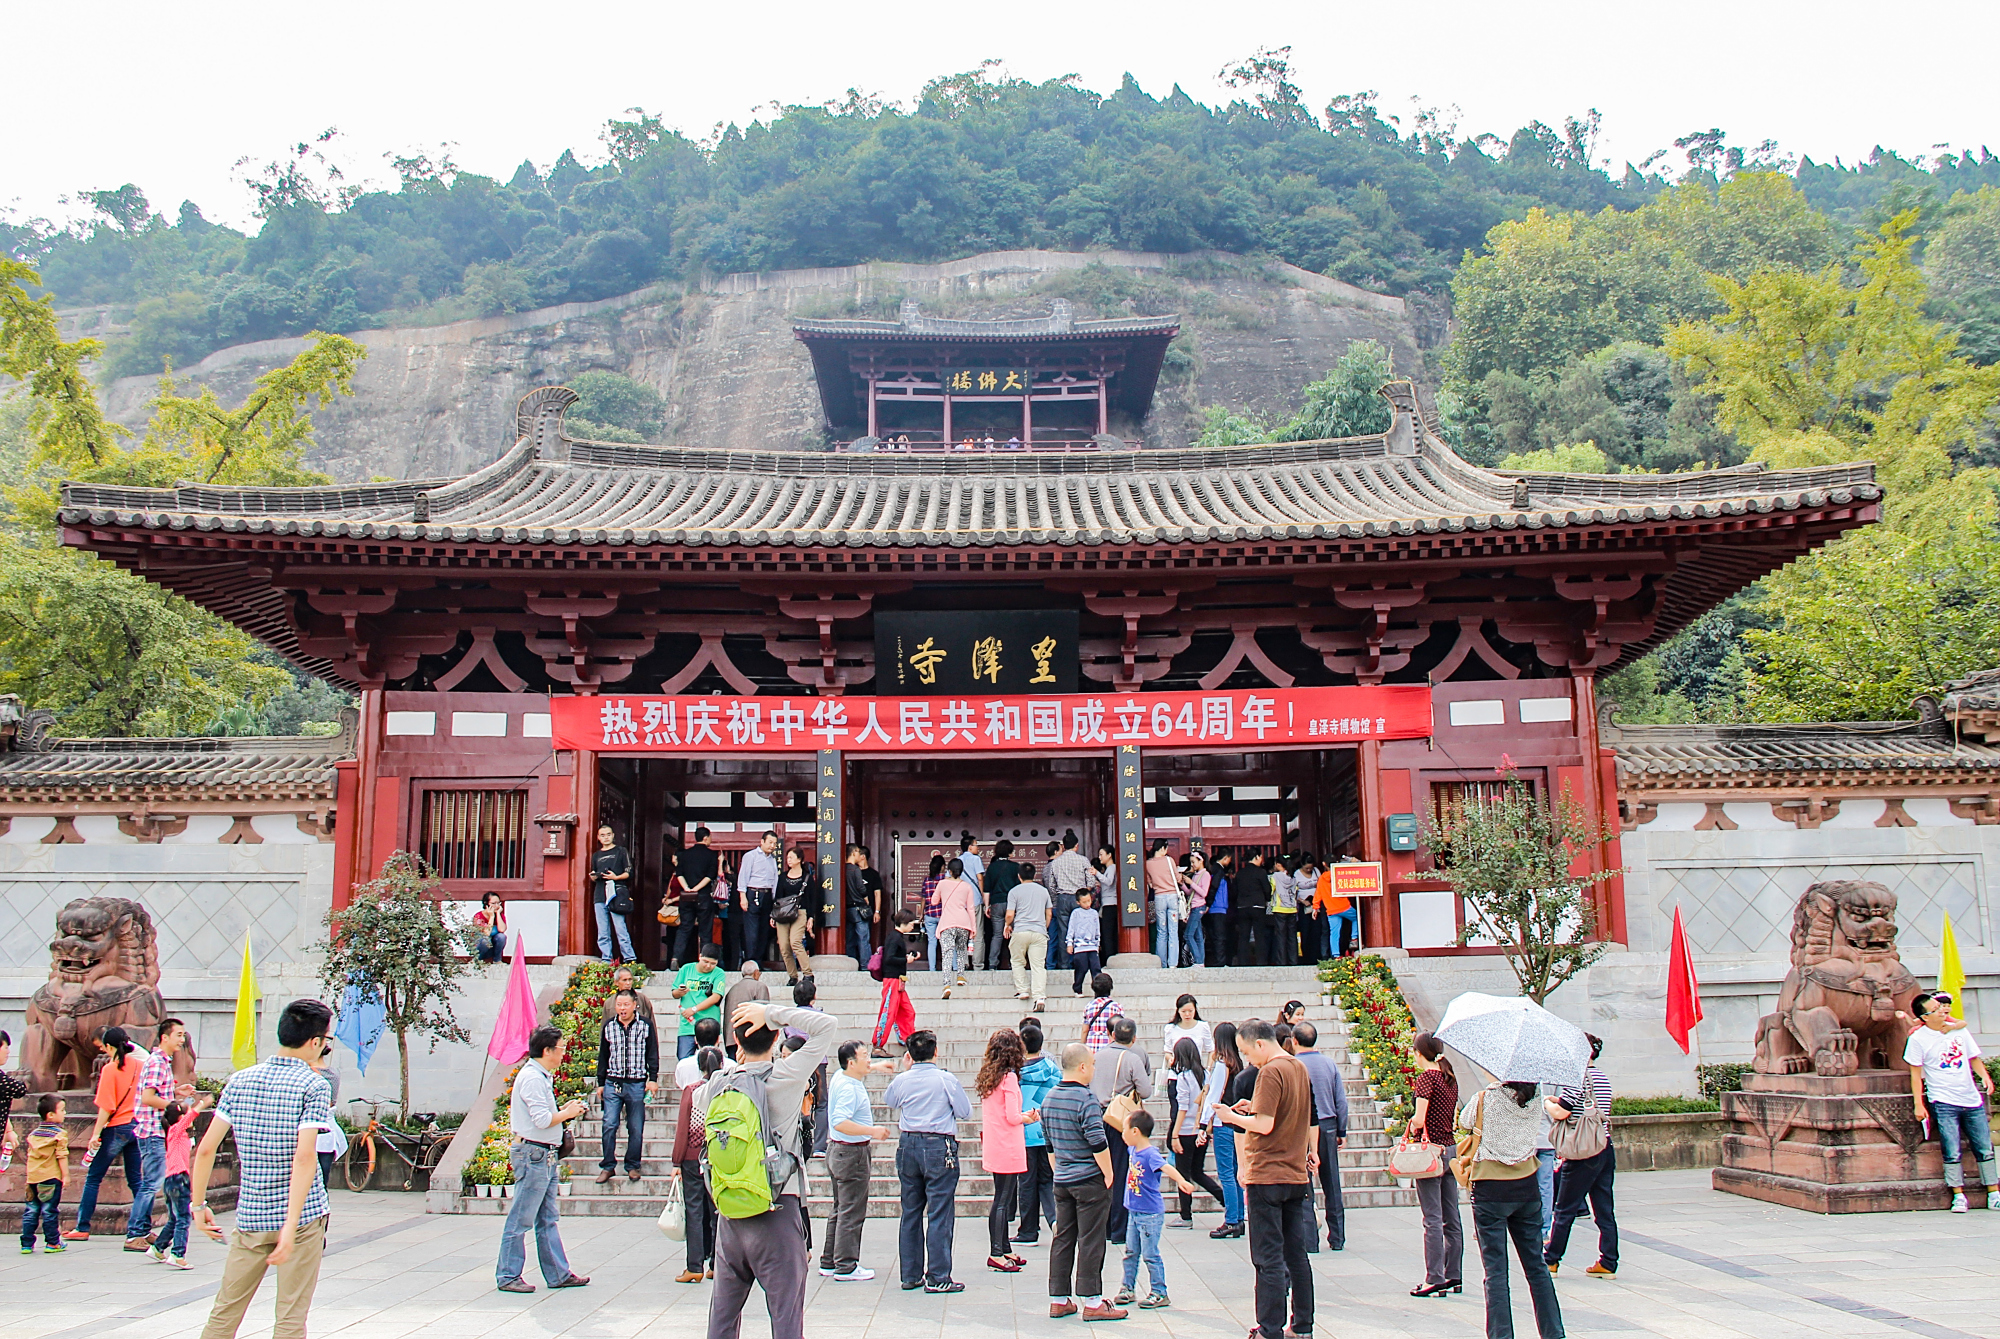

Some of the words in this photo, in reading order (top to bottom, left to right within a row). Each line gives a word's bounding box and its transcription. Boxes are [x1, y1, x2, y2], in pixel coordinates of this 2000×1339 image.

[1308, 718, 1370, 735] 皇泽寺博物馆
[1375, 717, 1386, 734] 宣
